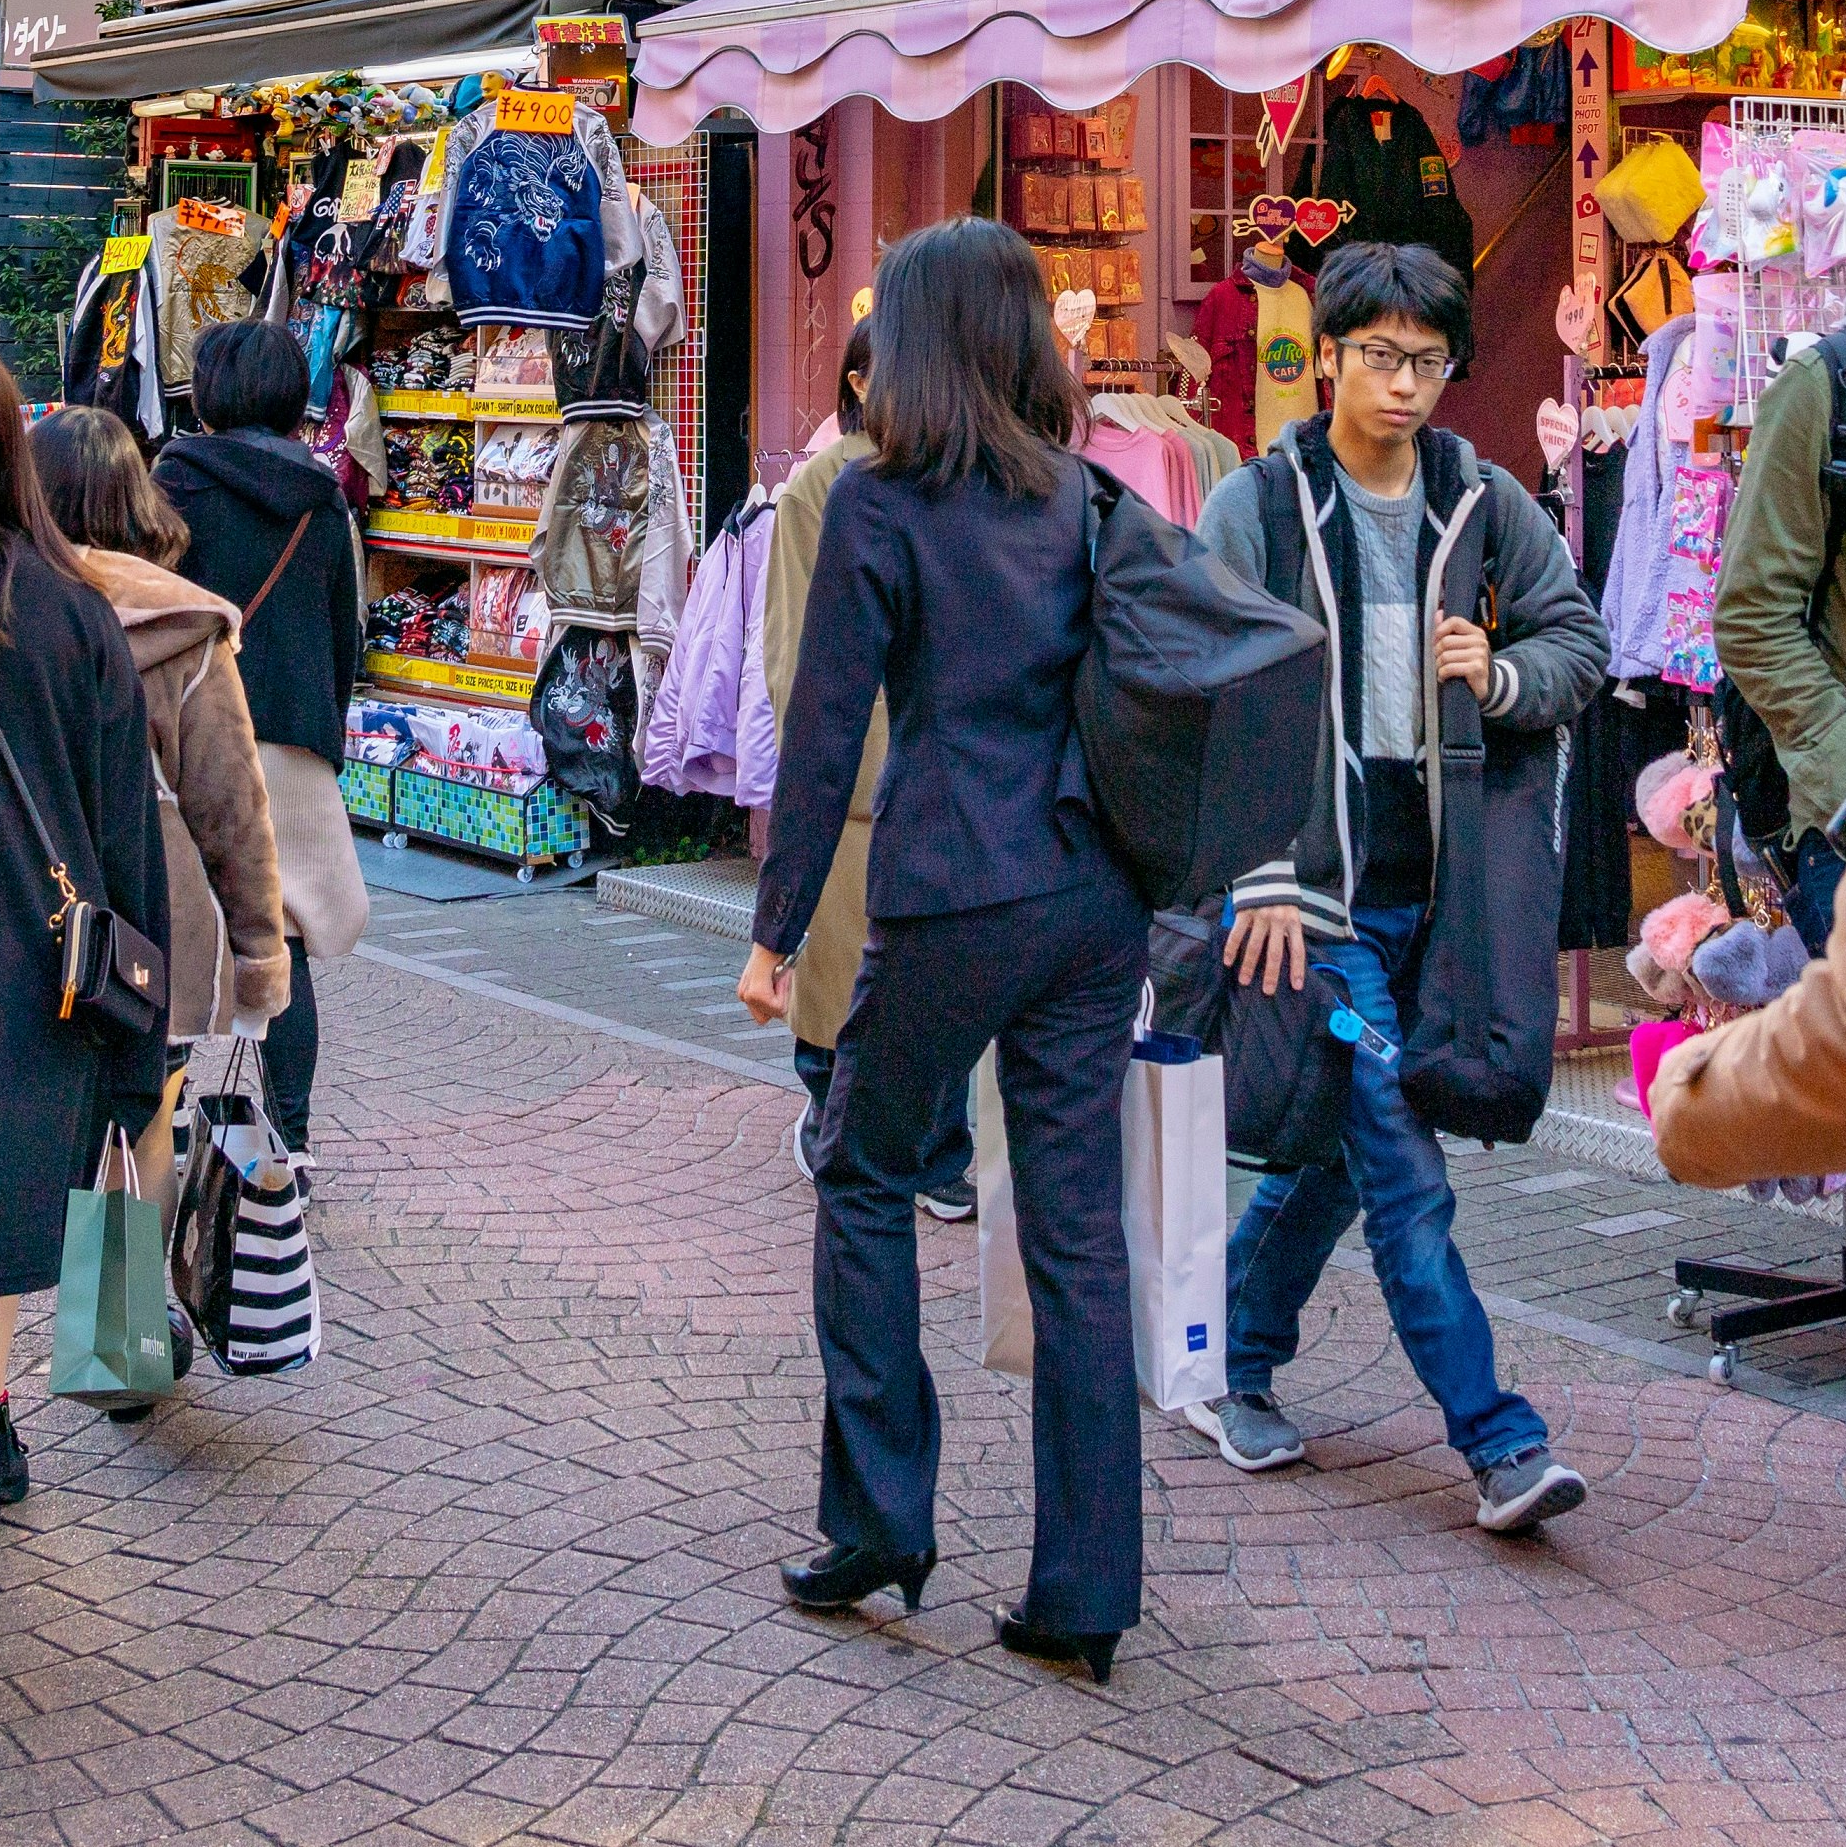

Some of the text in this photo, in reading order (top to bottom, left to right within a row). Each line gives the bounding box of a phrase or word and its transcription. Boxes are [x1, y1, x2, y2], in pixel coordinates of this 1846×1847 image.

[14, 14, 67, 56] ダイソー
[1577, 94, 1598, 106] CUTE
[499, 96, 572, 125] ¥4900
[1574, 108, 1601, 121] PHOTO
[1577, 122, 1599, 135] SPOT
[103, 240, 149, 271] ¥4200
[1273, 365, 1298, 379] CAFE
[471, 400, 490, 412] JAPAN
[516, 403, 534, 414] BLACK
[534, 403, 553, 415] COLOR
[1539, 416, 1576, 435] SPECIAL
[1543, 431, 1567, 449] PRICE
[475, 523, 521, 540] ¥1000 ¥1000
[455, 674, 464, 684] BIG
[465, 675, 477, 686] SIZE
[477, 677, 494, 689] PRICE
[505, 680, 518, 692] SIZE
